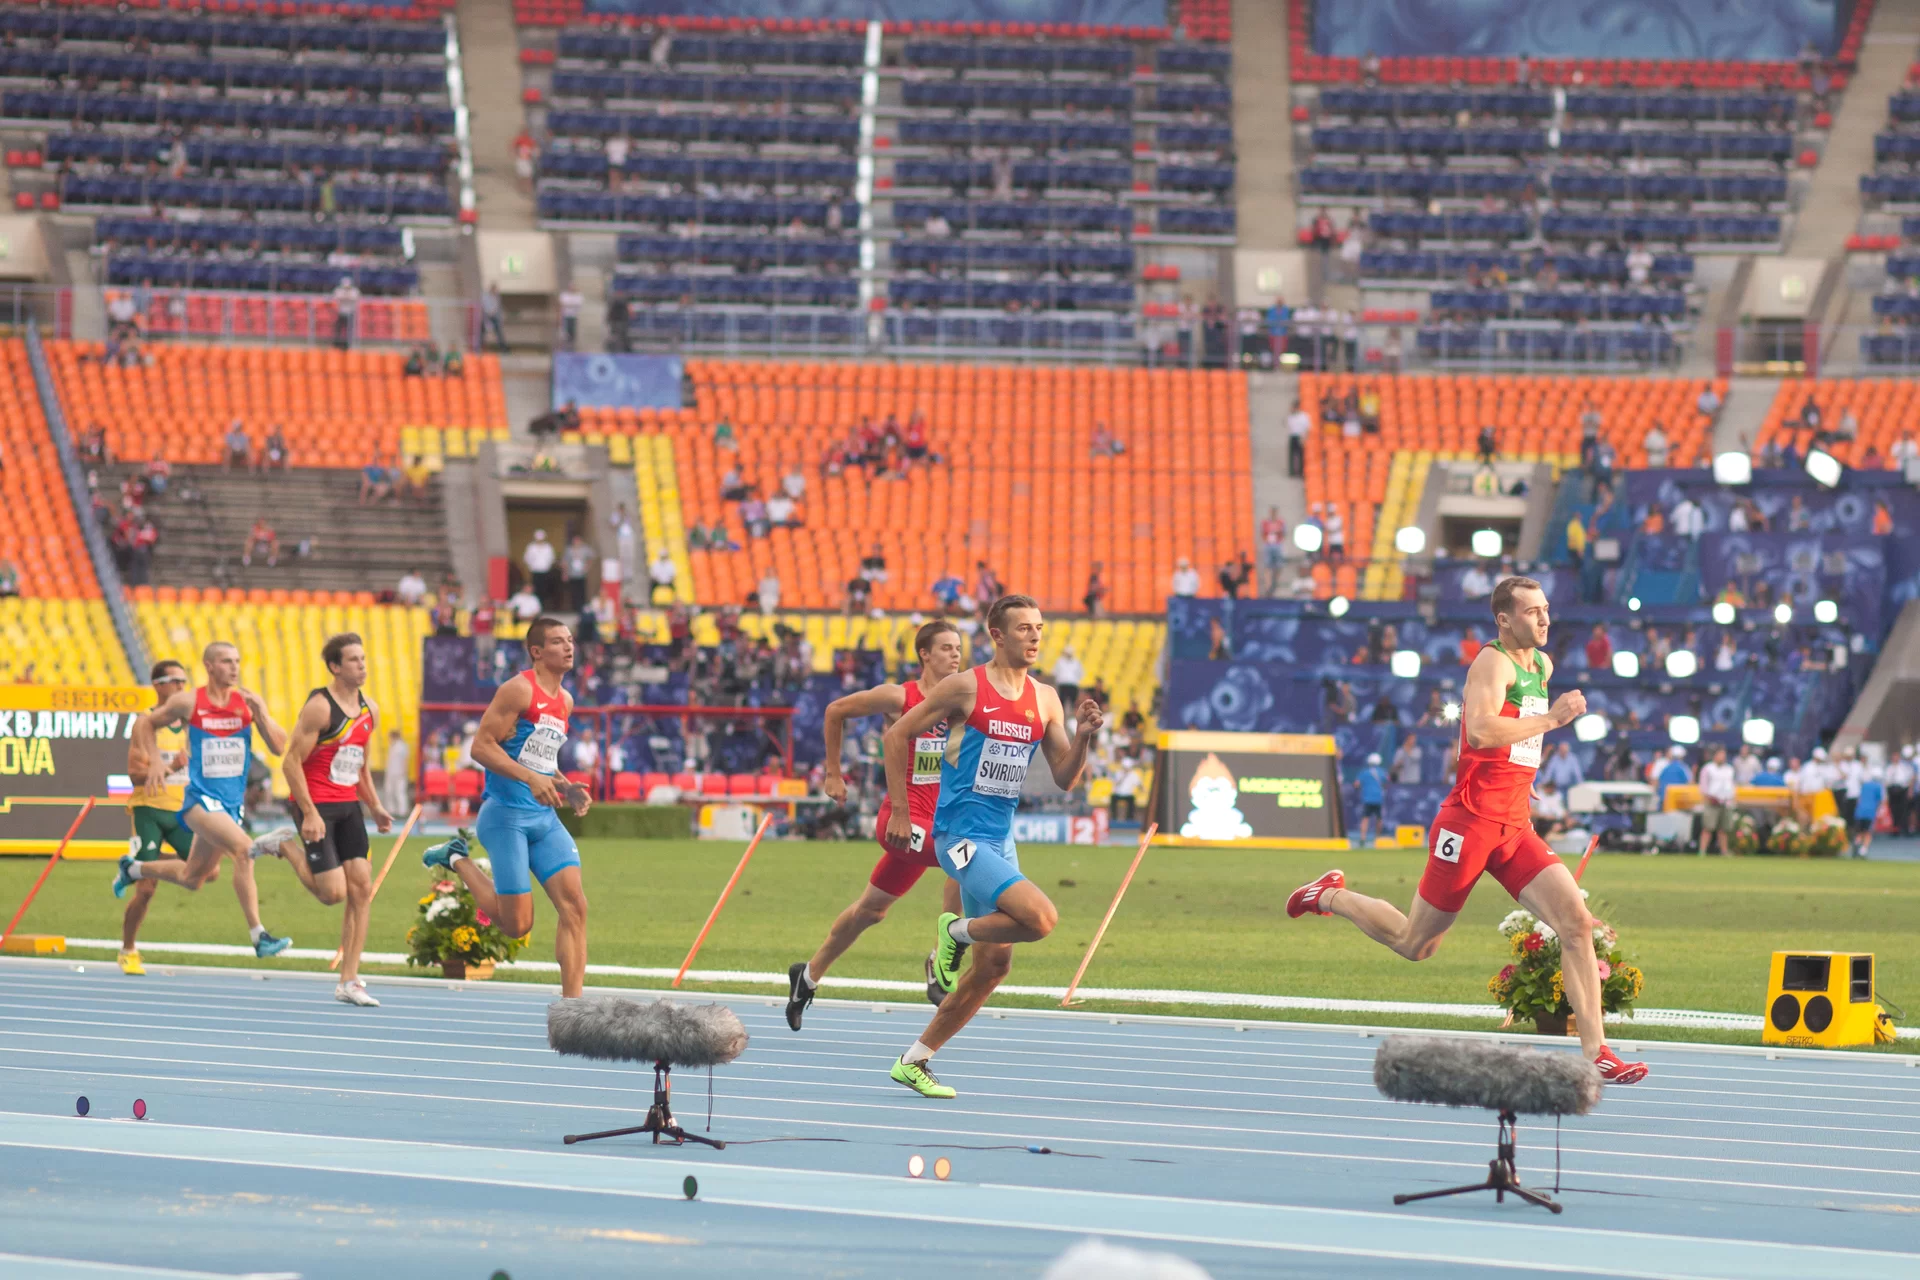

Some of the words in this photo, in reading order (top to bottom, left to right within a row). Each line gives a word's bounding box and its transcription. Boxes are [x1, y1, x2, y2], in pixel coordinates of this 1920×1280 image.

[51, 689, 140, 708] SEIKO
[34, 711, 119, 739] ДЛИНУ
[988, 719, 1032, 741] RUSSIA
[1001, 743, 1027, 758] TDK
[980, 760, 1027, 782] SVIRIDOV
[975, 784, 1010, 795] MOSCOW
[957, 843, 968, 863] 7
[1442, 837, 1455, 857] 6
[1786, 1035, 1814, 1045] SEIKO
